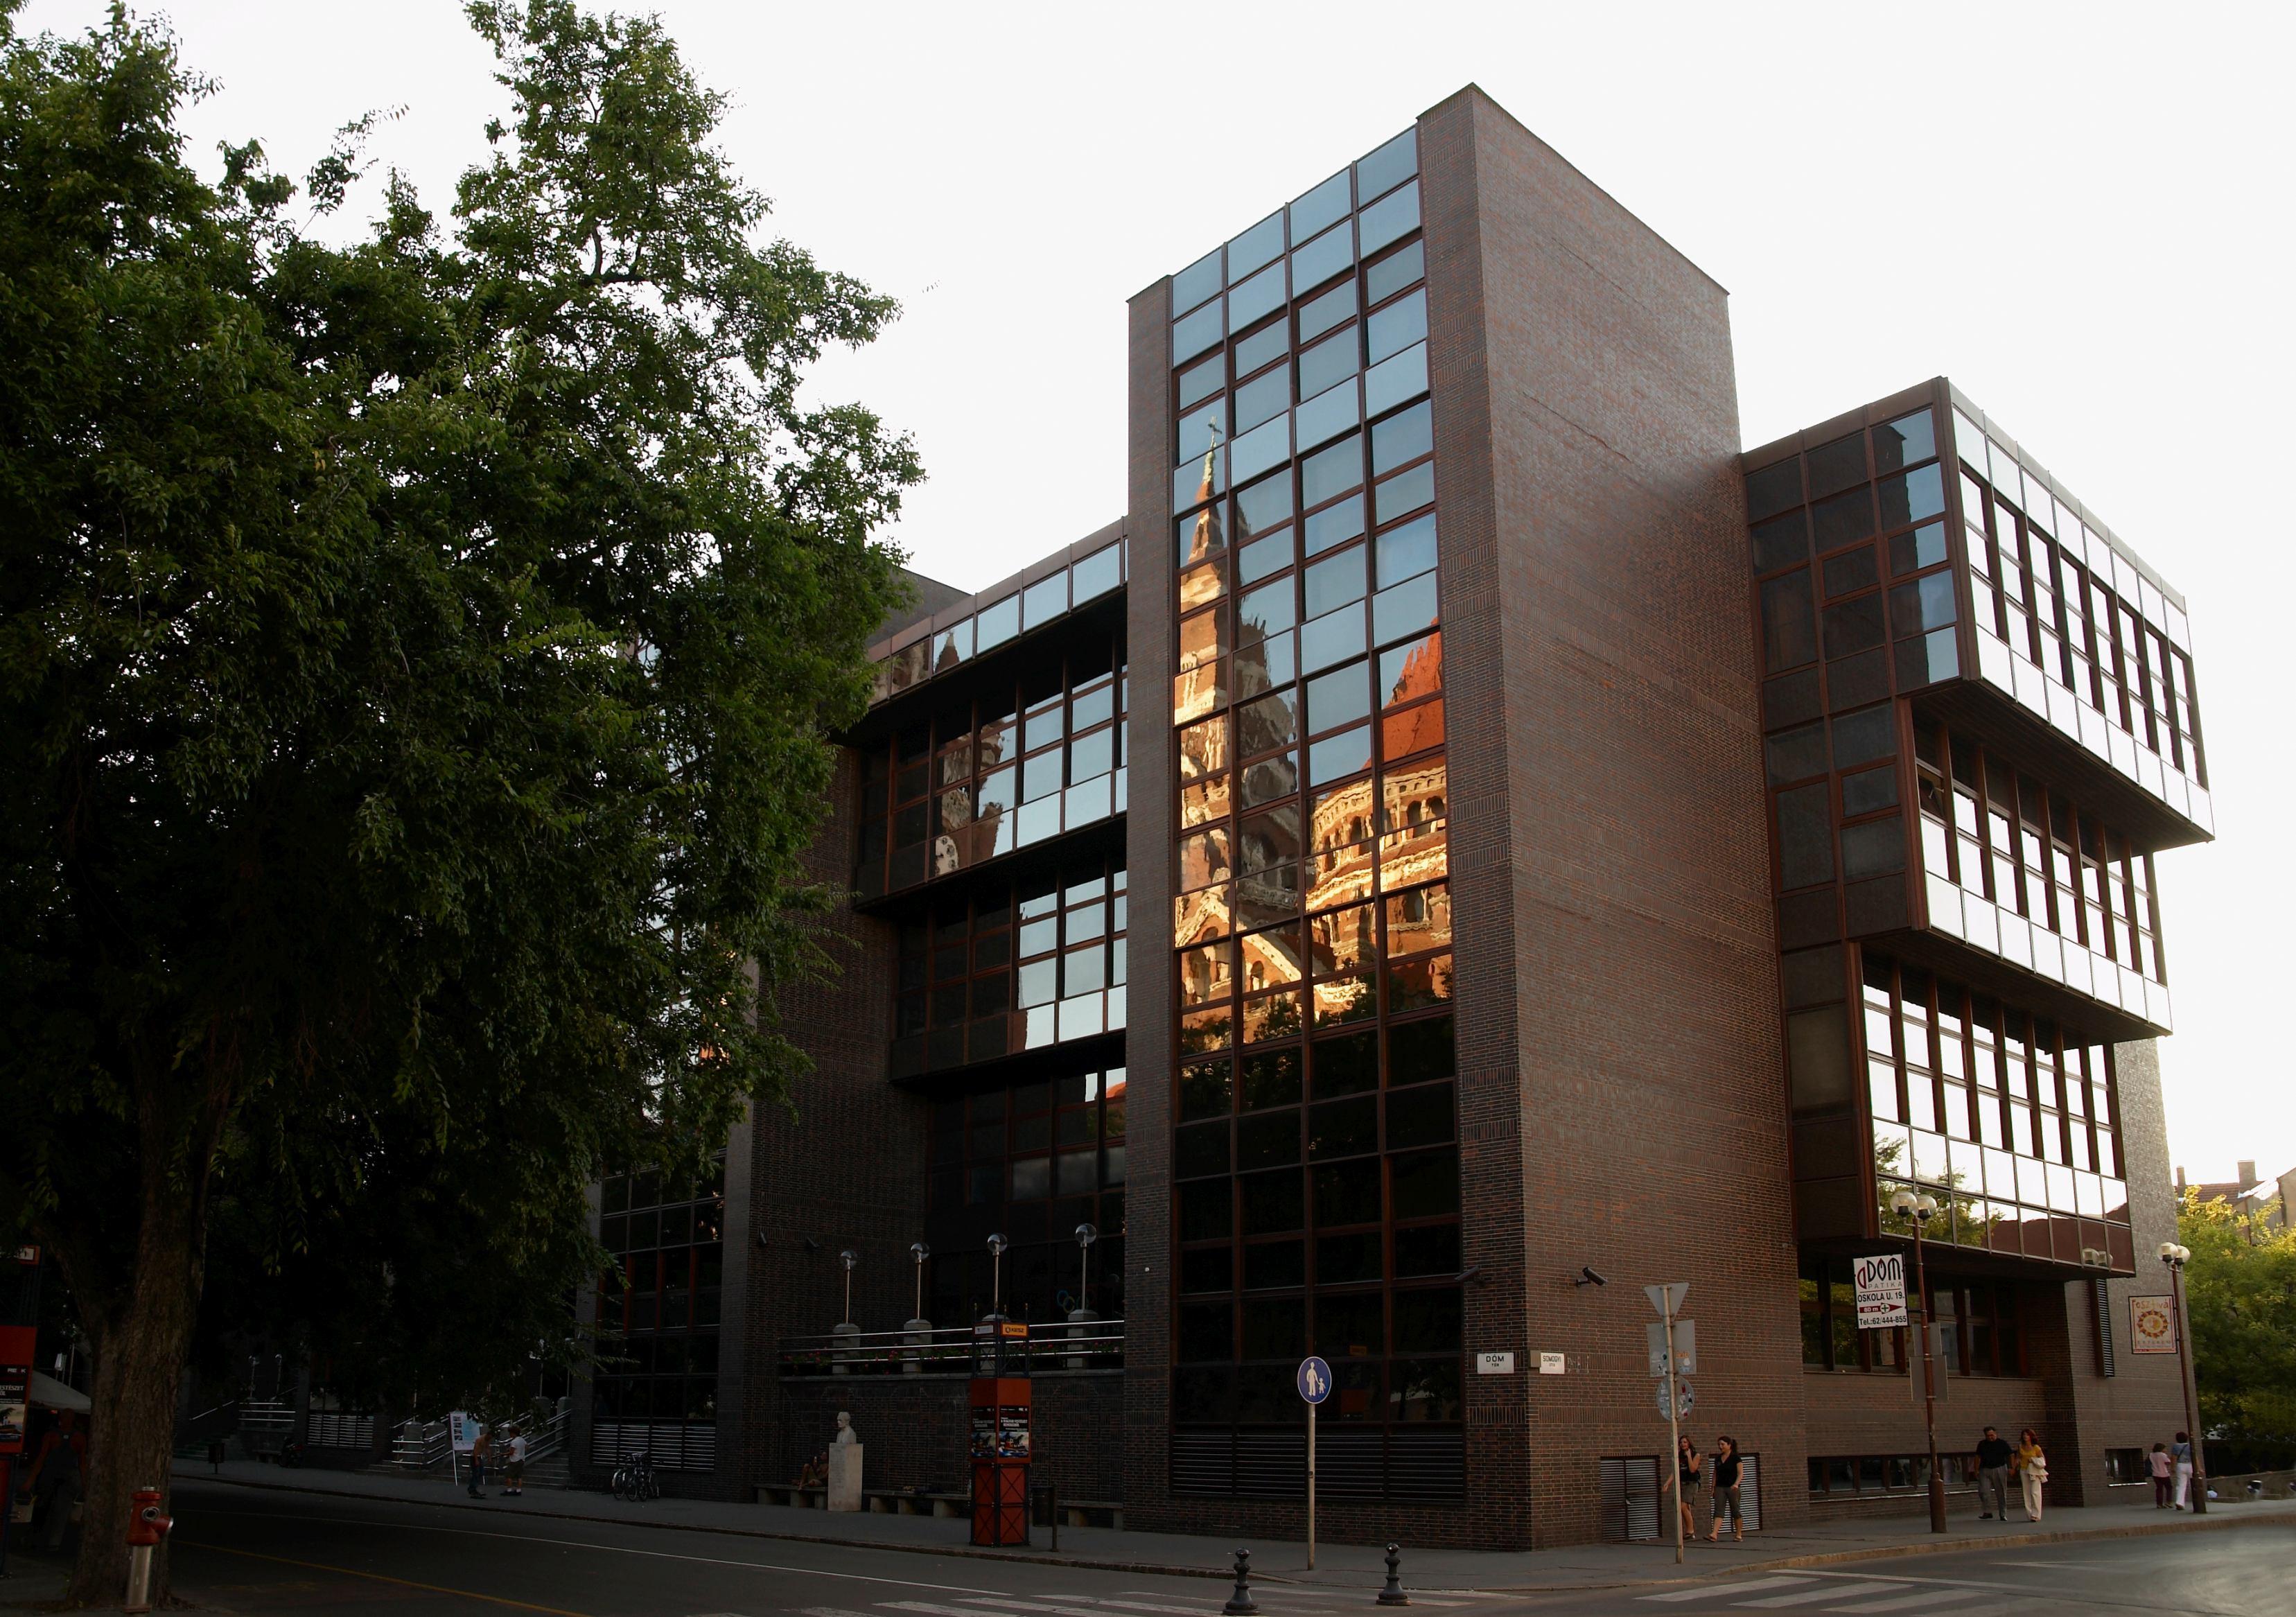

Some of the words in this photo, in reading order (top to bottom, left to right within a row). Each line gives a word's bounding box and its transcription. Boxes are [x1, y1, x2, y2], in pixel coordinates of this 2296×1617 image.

[1868, 1281, 1903, 1289] PATIKA
[1857, 1293, 1885, 1302] OSKOLA
[1886, 1292, 1893, 1300] U.
[1895, 1291, 1904, 1300] 19.
[1486, 1354, 1505, 1363] DÓM
